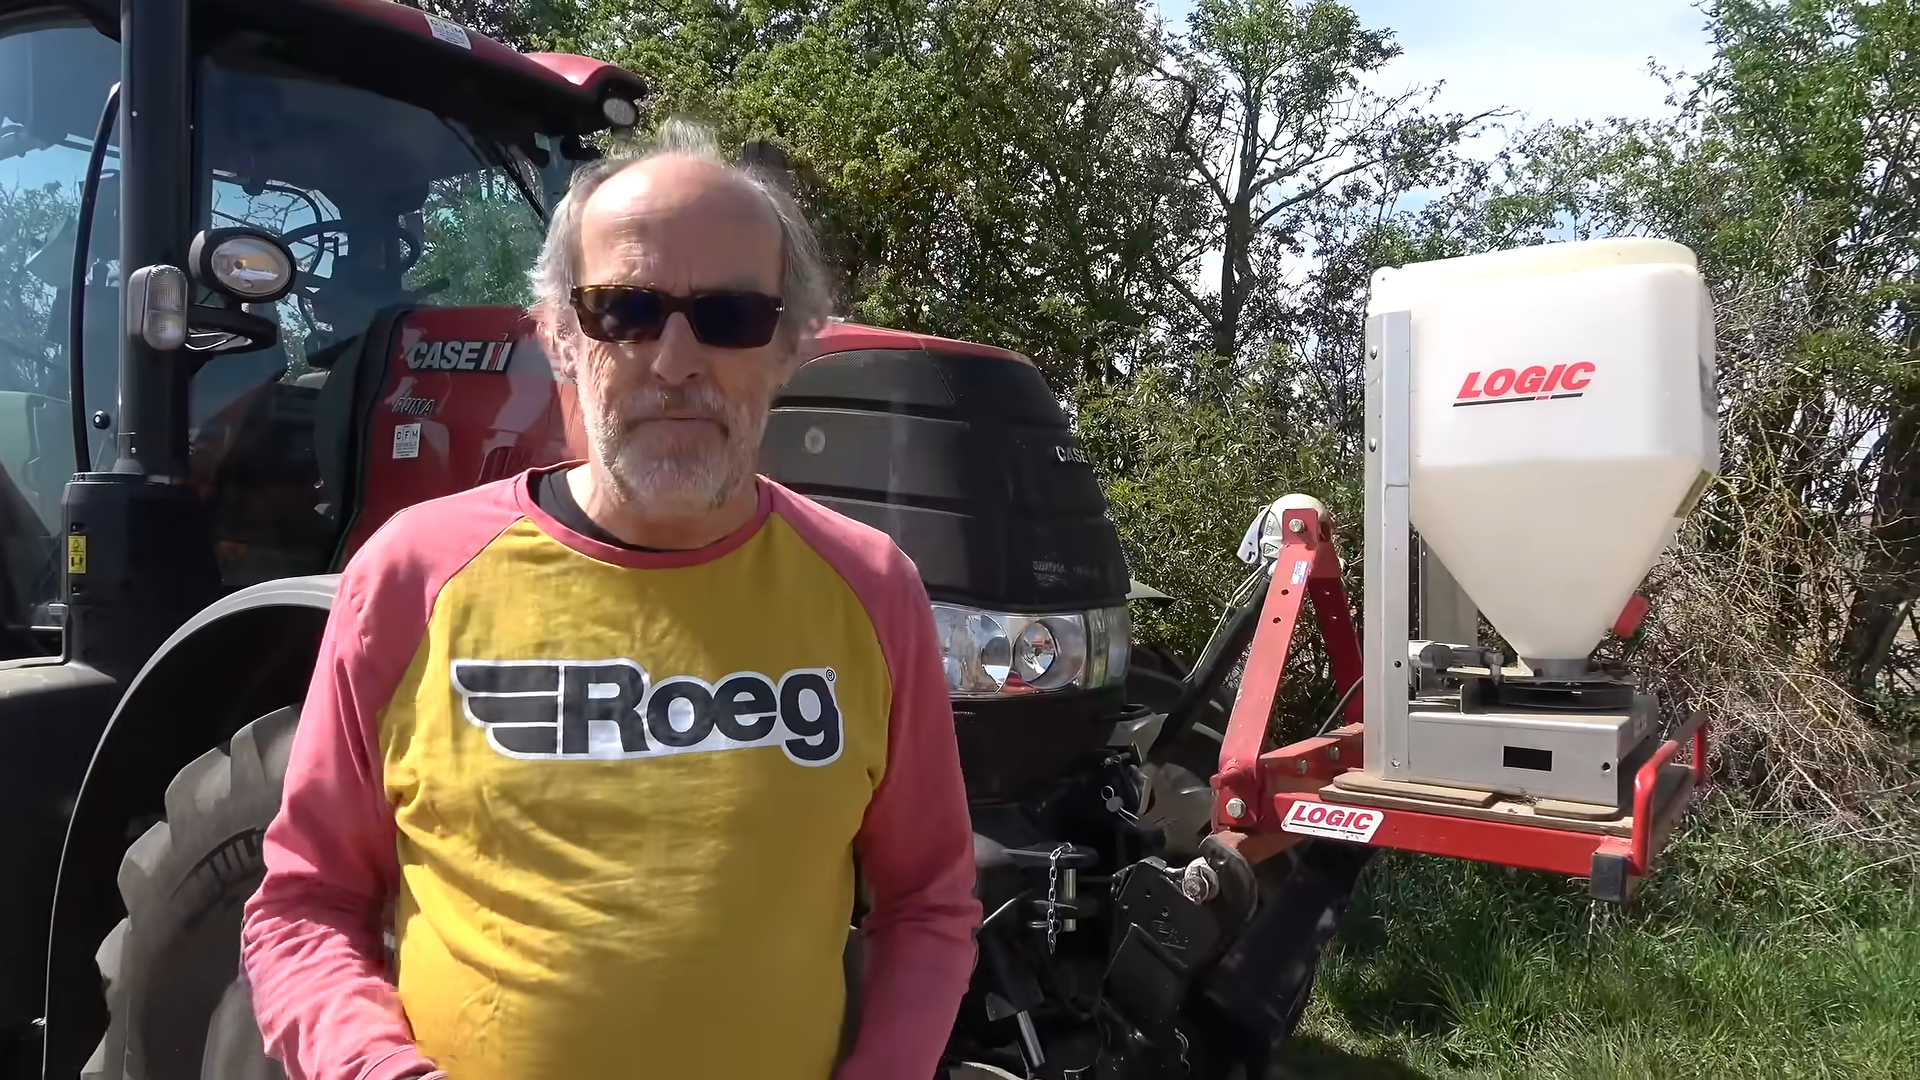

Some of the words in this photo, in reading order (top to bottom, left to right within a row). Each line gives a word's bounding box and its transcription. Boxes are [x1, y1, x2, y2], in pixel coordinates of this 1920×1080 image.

[407, 341, 482, 370] CASE
[1456, 361, 1596, 399] LOGIC
[1292, 805, 1374, 830] LOGIC
